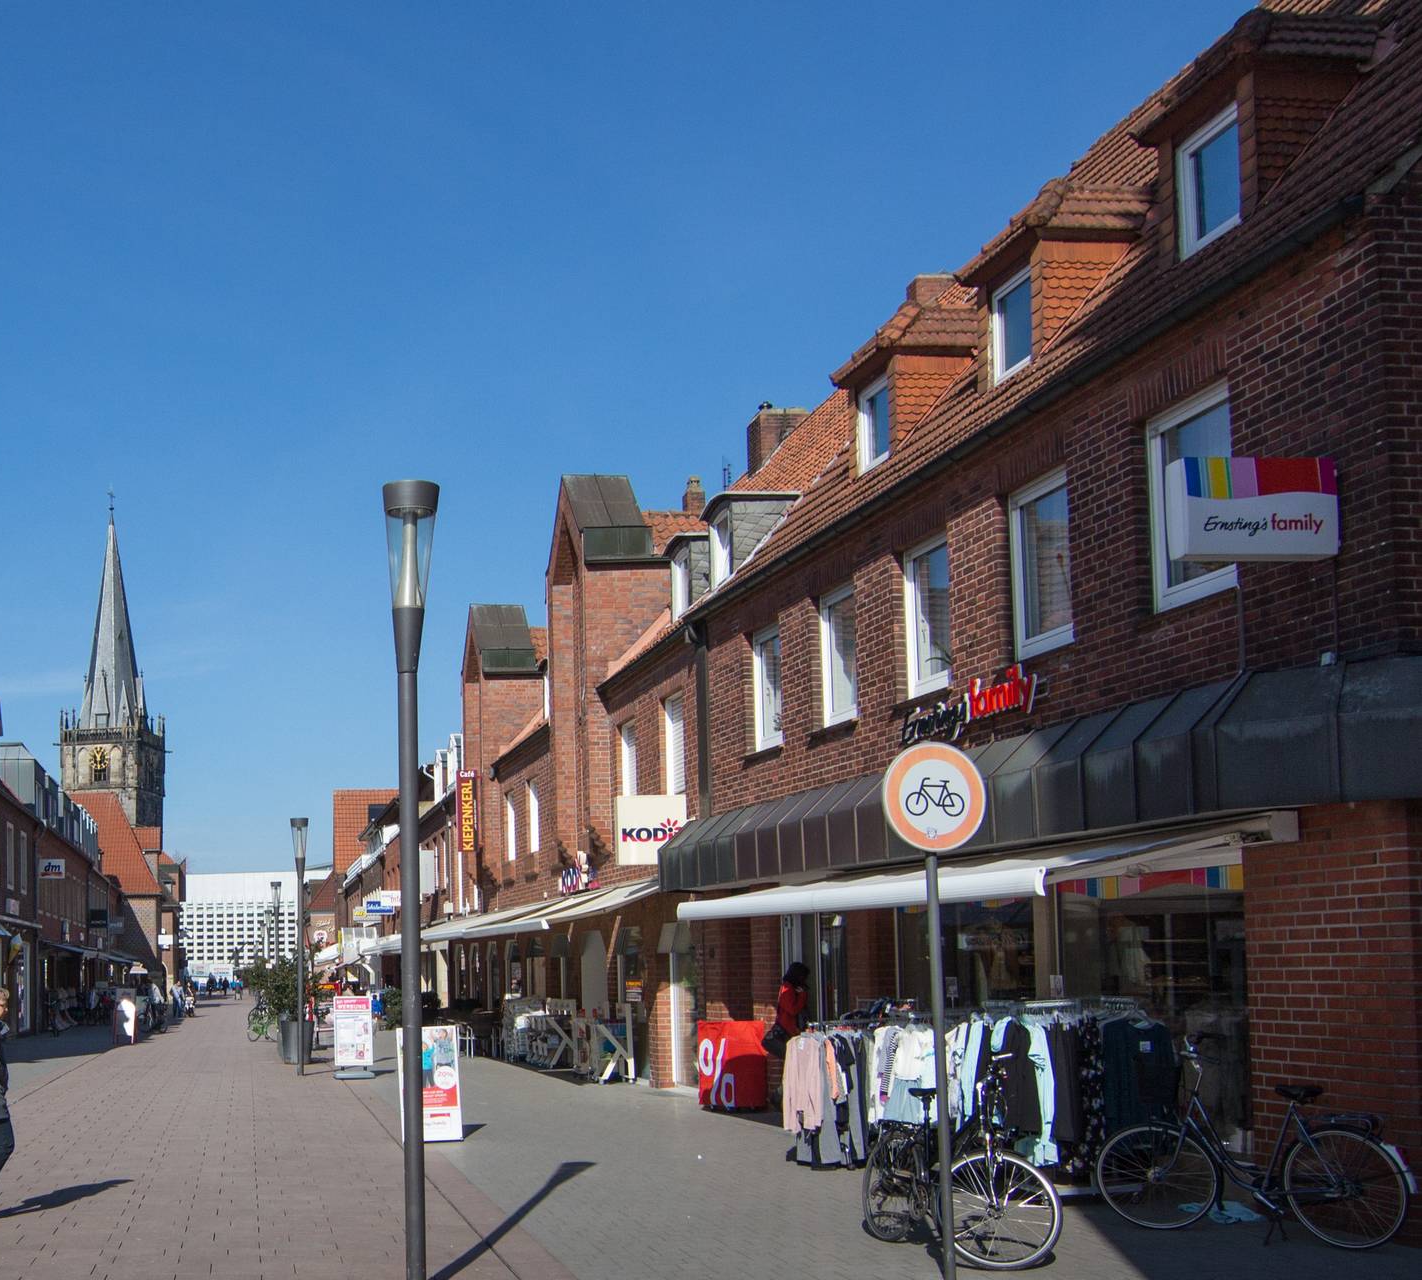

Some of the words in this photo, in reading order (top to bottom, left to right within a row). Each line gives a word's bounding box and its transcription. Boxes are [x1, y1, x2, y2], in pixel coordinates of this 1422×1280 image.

[1203, 515, 1268, 537] Ernsting's
[1271, 513, 1324, 534] family
[969, 664, 1037, 720] family
[459, 770, 475, 778] Café
[461, 779, 474, 851] KIEPENKERL
[44, 862, 61, 872] dm
